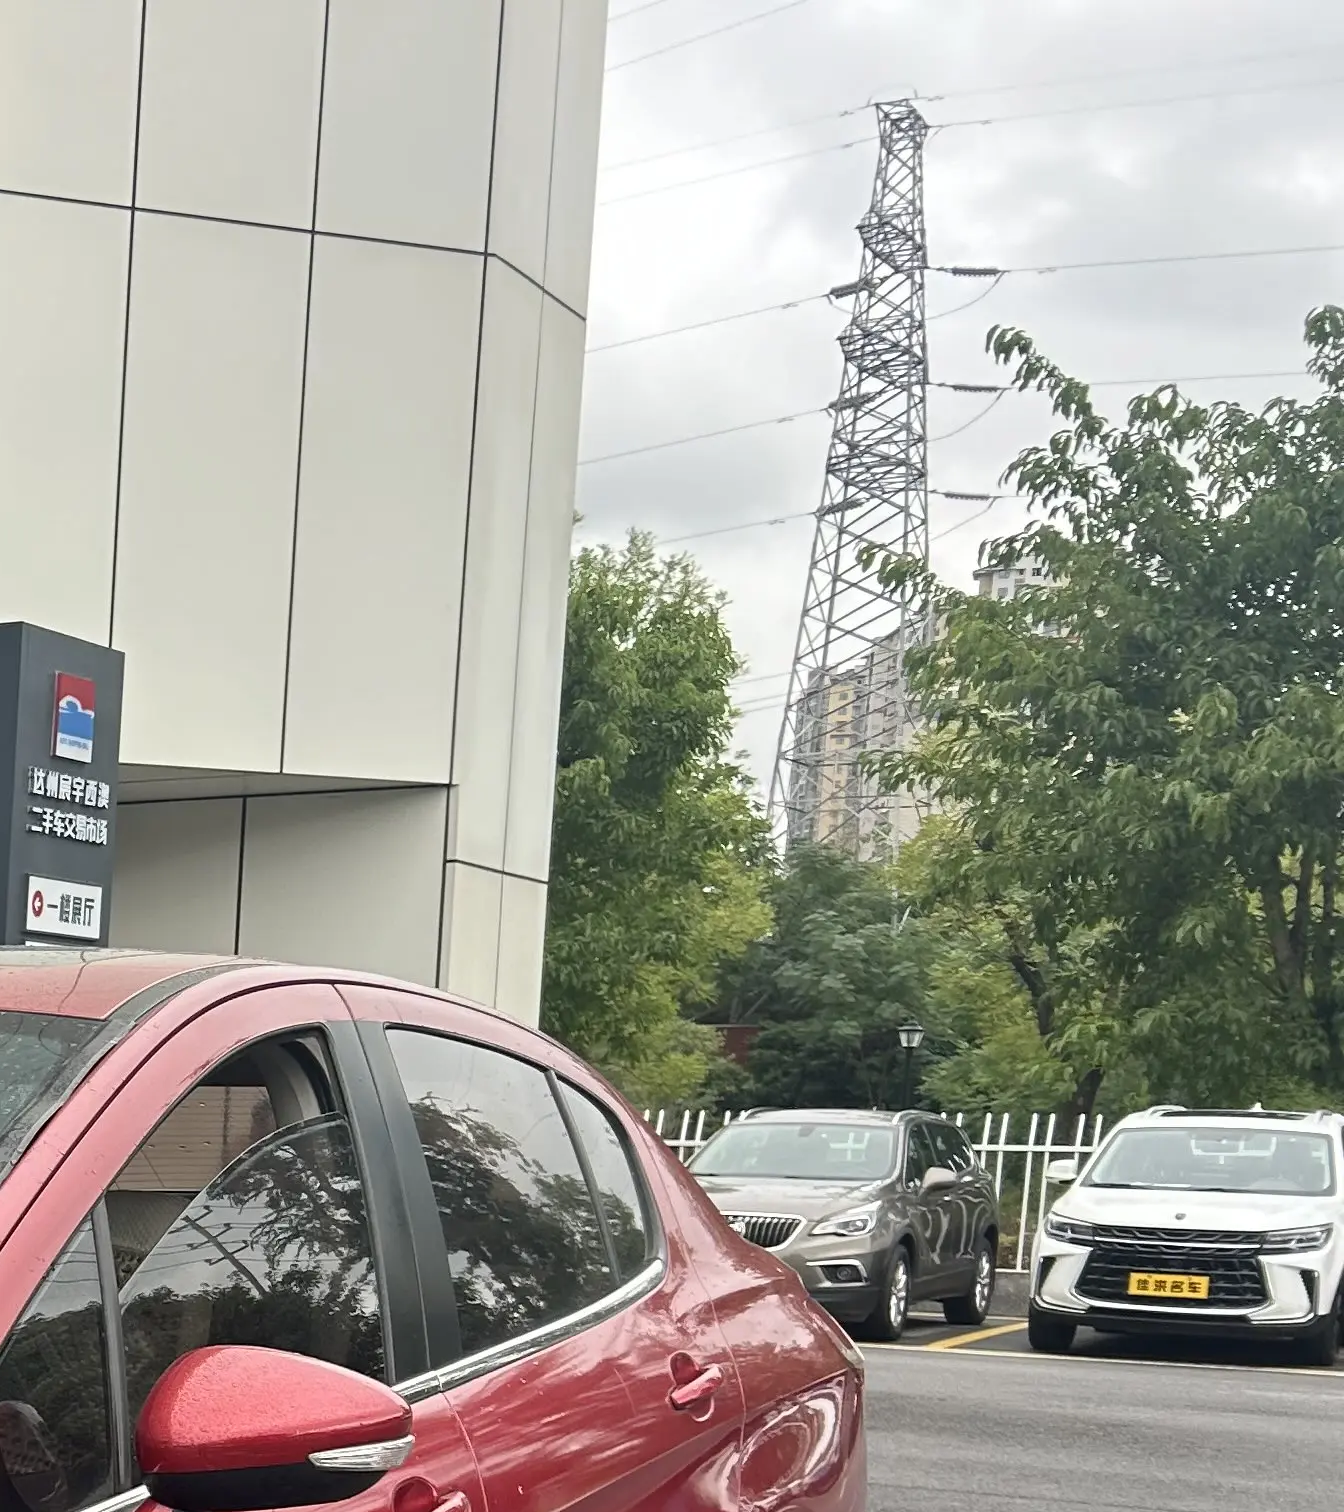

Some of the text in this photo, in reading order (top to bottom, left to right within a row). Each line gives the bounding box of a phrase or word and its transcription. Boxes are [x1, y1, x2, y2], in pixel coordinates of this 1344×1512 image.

[26, 805, 109, 846] 二手车交易市场
[46, 893, 95, 927] 一楼展厅
